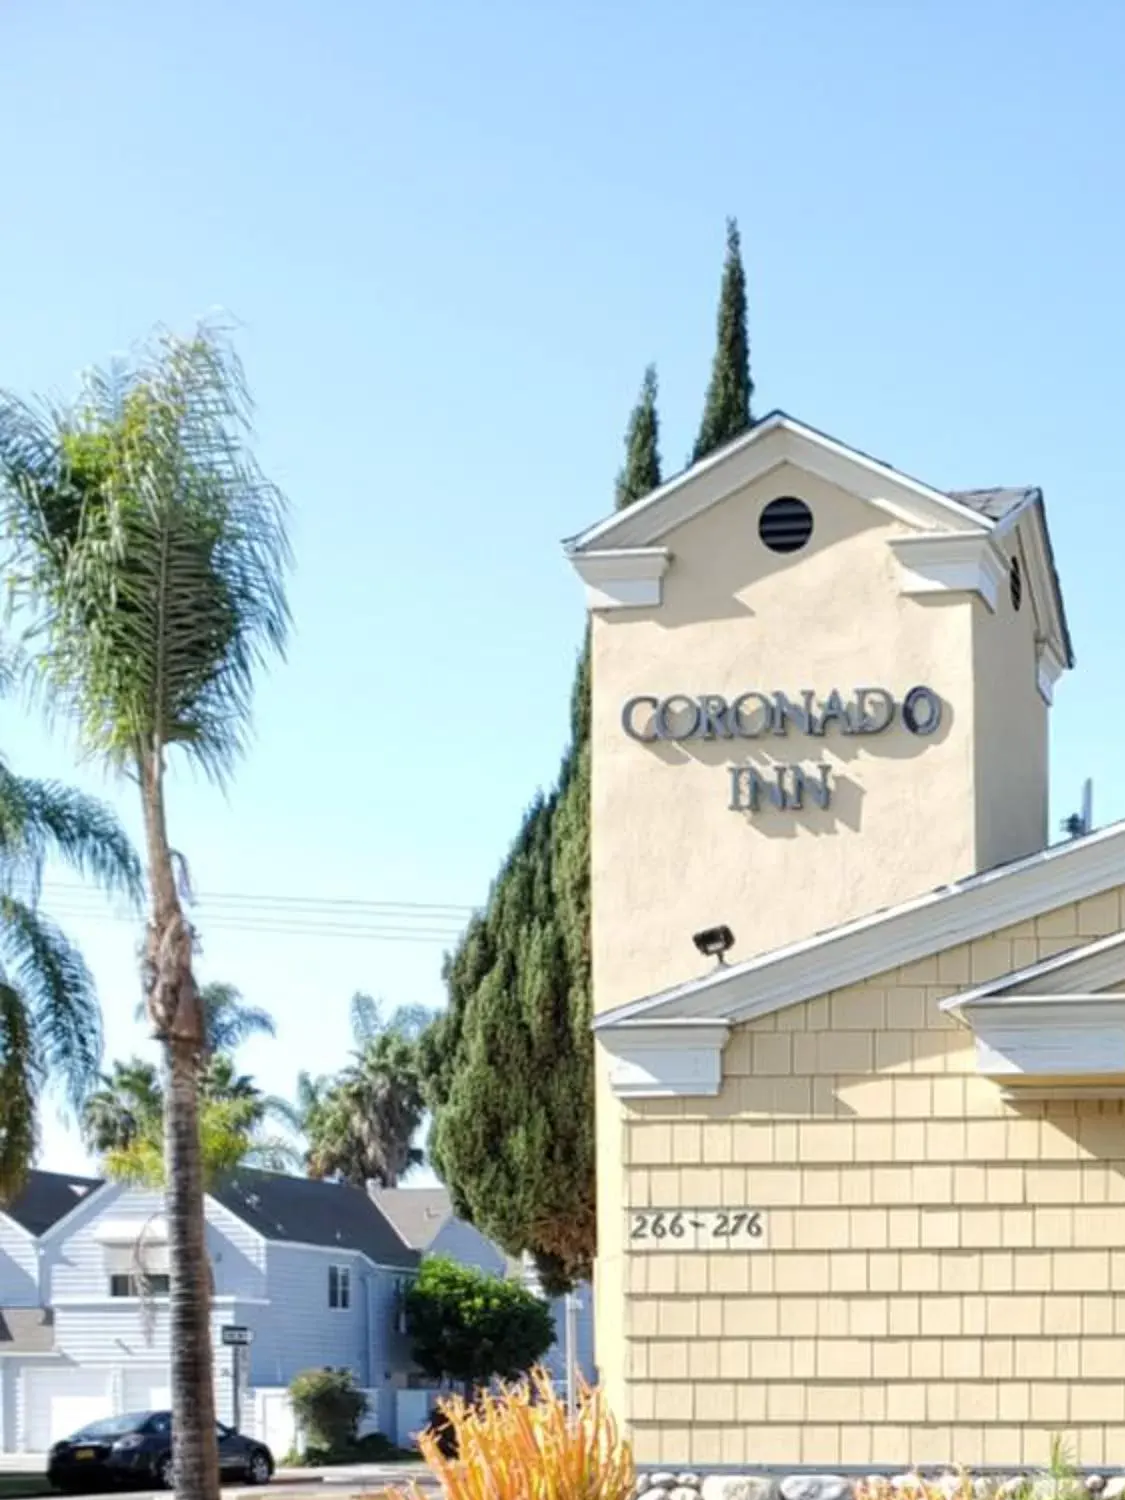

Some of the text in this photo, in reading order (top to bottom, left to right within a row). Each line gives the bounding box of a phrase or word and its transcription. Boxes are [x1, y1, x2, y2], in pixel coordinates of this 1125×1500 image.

[621, 685, 942, 743] CORONADO
[728, 763, 832, 812] INN
[630, 1212, 763, 1239] 266-276
